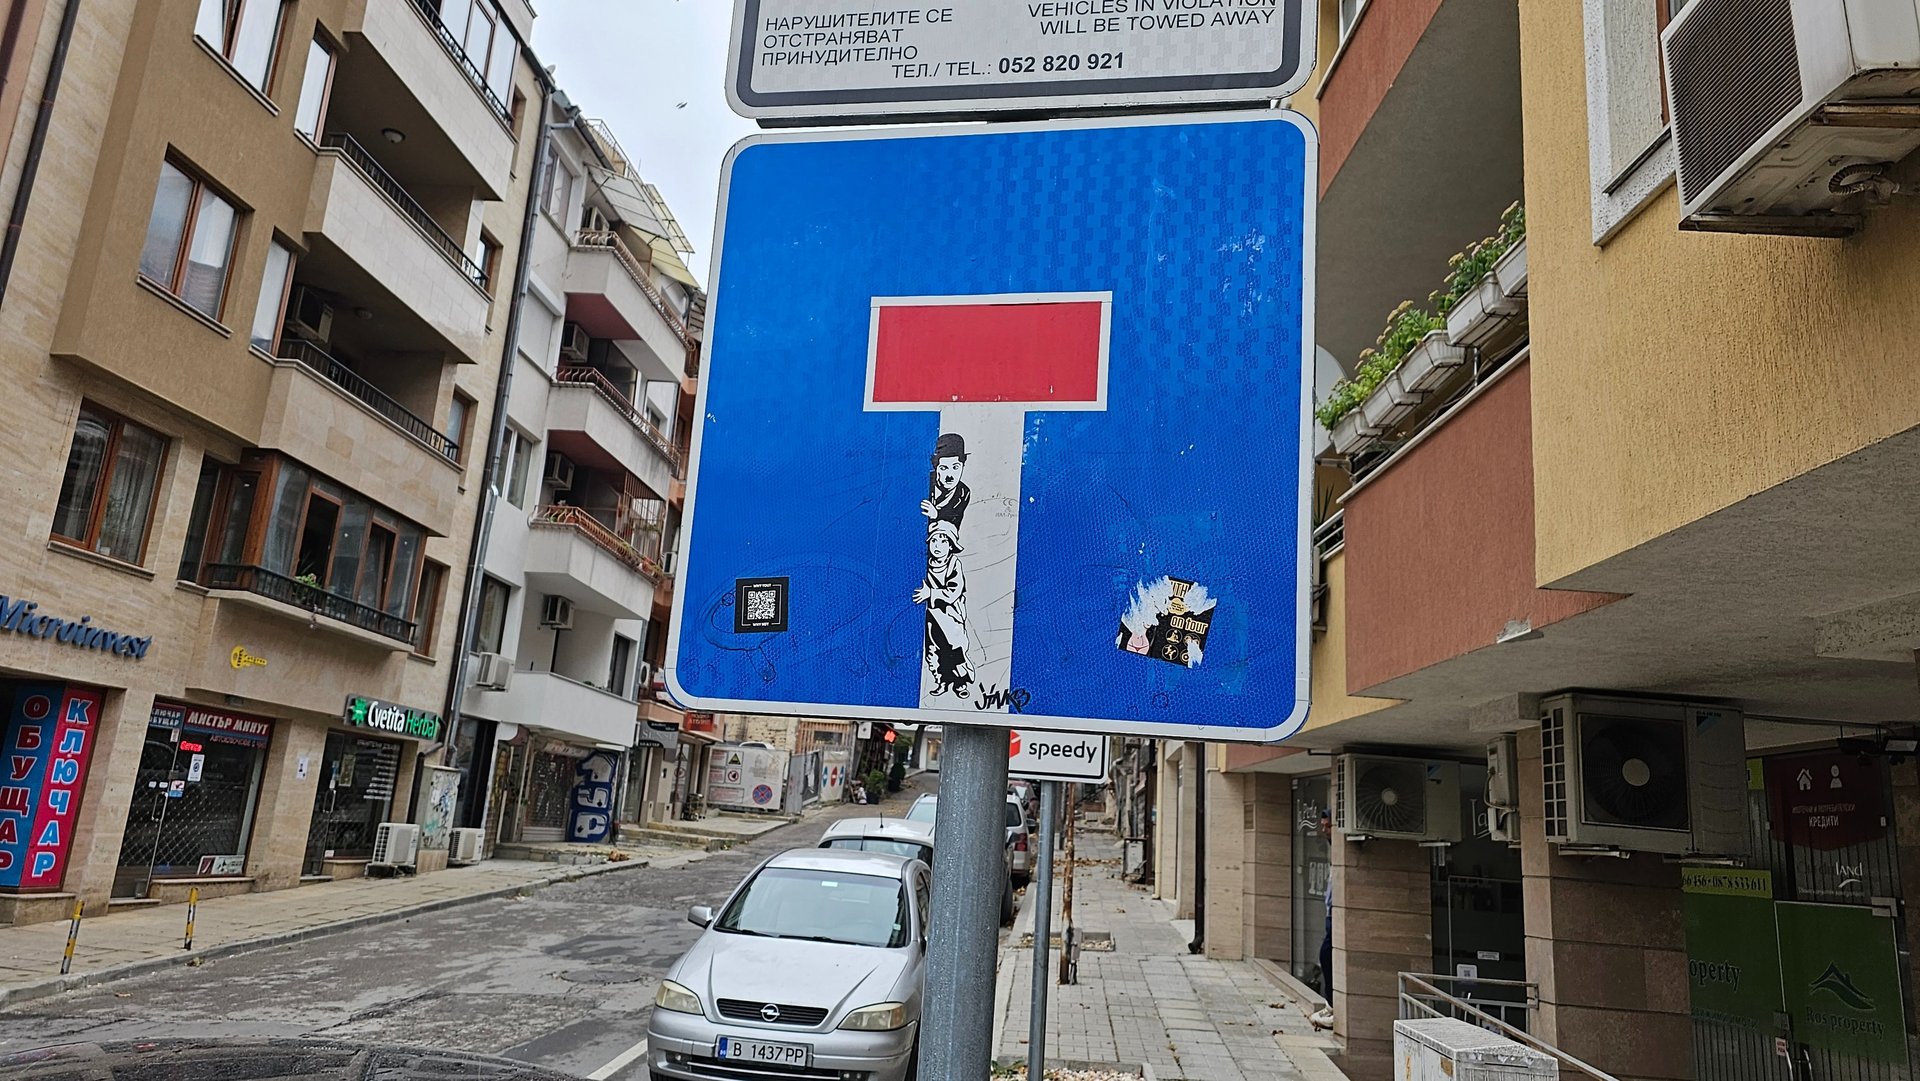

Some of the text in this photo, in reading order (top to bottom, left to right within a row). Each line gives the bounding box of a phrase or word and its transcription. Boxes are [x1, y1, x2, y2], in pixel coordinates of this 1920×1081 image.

[765, 8, 953, 31] НАРУШИТЕЛИТЕ СЕ
[1028, 0, 1128, 18] VEHICLES
[1135, 0, 1155, 12] IN
[1040, 9, 1275, 35] WILL BE TOWED AWAY
[763, 28, 904, 49] ОТСТРАНЯВАТ
[761, 45, 918, 66] ПРИНУДИТЕЛНО
[892, 52, 1124, 79] ТЕЛ./ TEL.: 052 820 921
[0, 594, 153, 659] Microinvest
[1171, 616, 1208, 634] on tour
[187, 711, 269, 736] МИСТЪР МИНУТ
[367, 701, 440, 738] Cvetita Herbal
[1028, 740, 1098, 764] speedy
[31, 697, 93, 879] КЛЮЧАР
[1809, 815, 1840, 829] КРЕДИТИ
[1830, 1015, 1884, 1040] property
